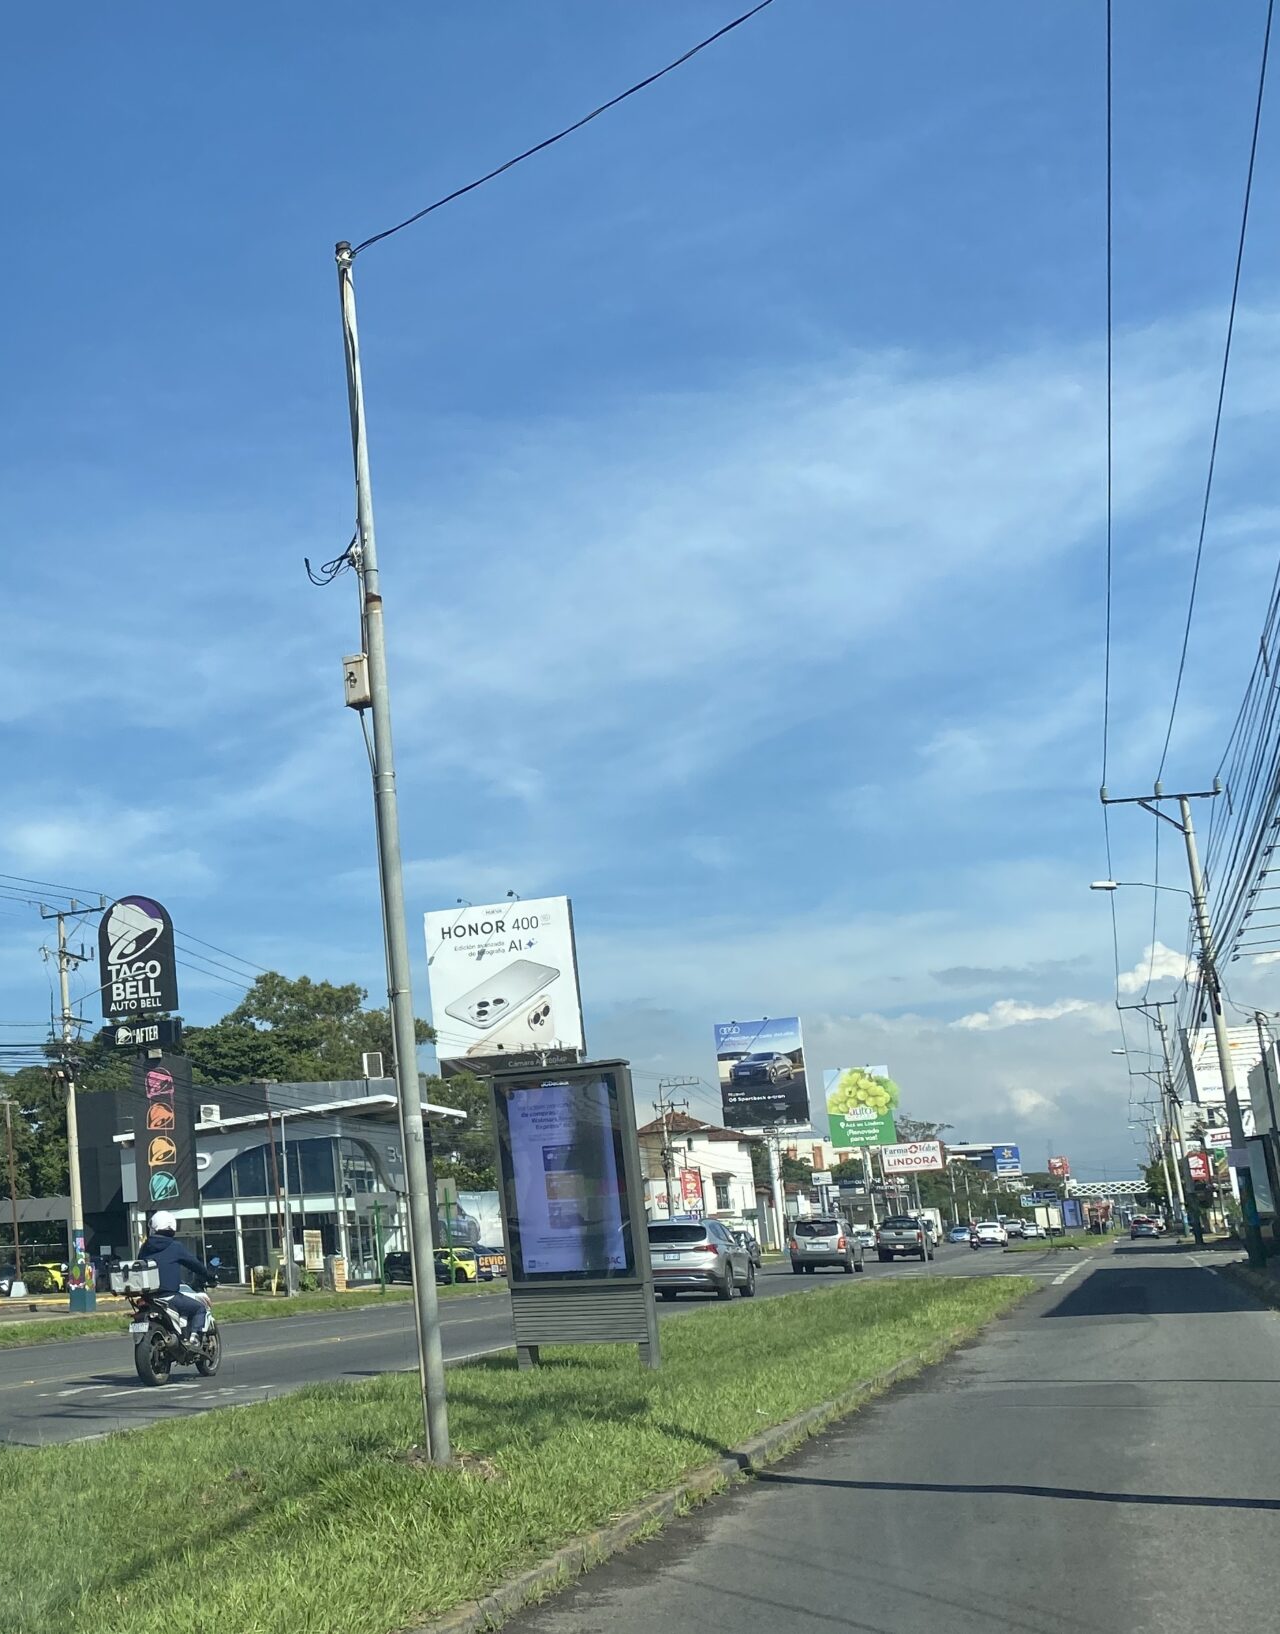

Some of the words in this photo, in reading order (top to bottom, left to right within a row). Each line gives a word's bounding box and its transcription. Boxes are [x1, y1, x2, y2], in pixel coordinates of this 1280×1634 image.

[441, 919, 506, 940] HONOR
[511, 915, 539, 932] 400
[107, 960, 162, 982] TACO
[112, 978, 162, 1001] BELL
[110, 999, 138, 1012] AUTO
[140, 997, 162, 1009] BELL
[135, 1025, 159, 1044] AFTER
[883, 1147, 908, 1155] Farma
[887, 1156, 938, 1167] LINDORA
